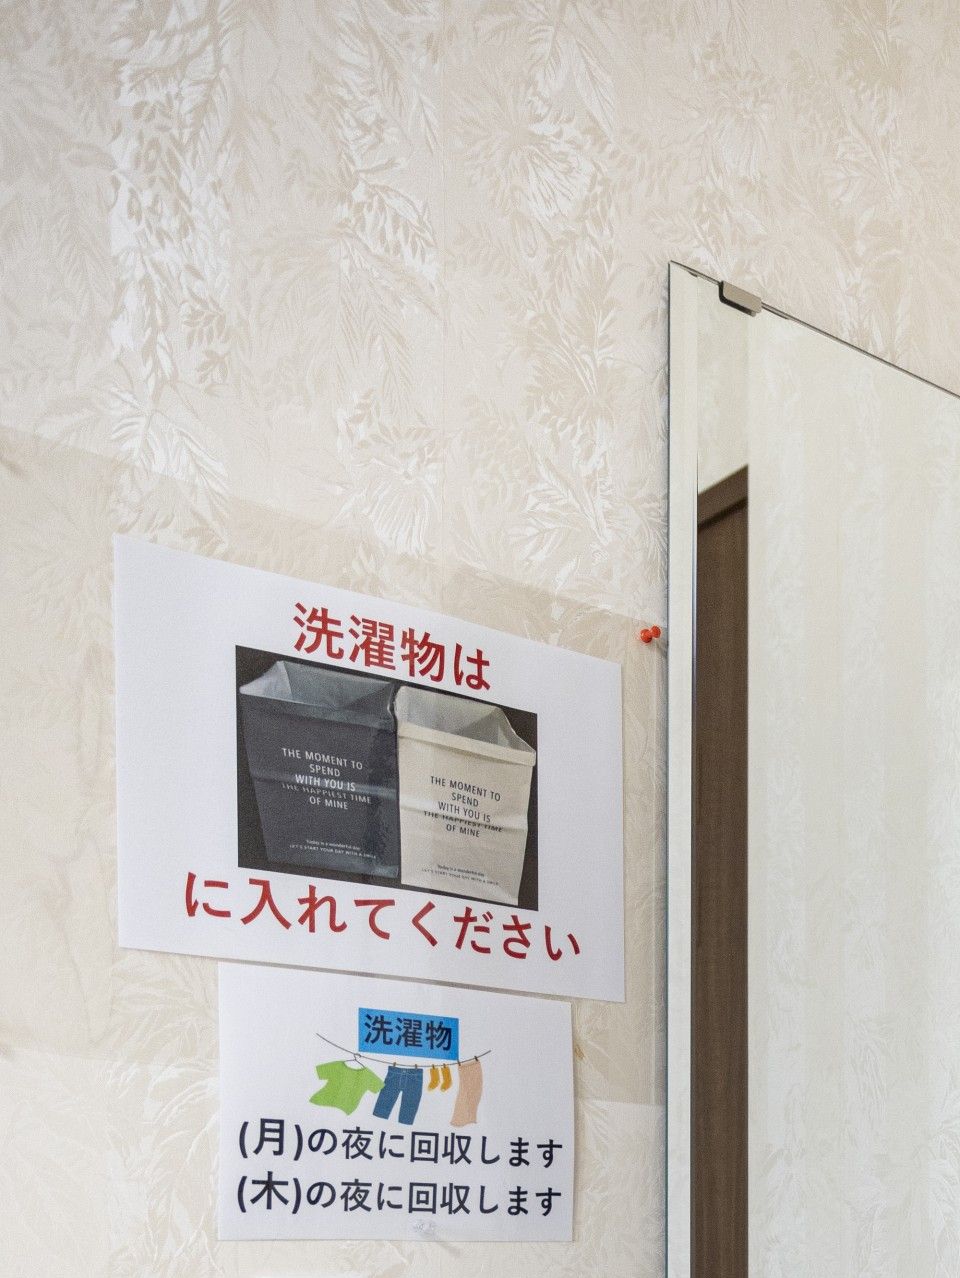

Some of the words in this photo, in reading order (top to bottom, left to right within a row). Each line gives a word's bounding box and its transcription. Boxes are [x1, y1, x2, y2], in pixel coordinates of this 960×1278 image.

[293, 602, 491, 691] 洗濯物は
[282, 748, 301, 759] THE
[305, 751, 347, 767] MOMENT
[352, 761, 363, 770] TO
[309, 764, 341, 777] SPEND
[295, 774, 320, 788] WITH
[324, 779, 343, 790] YOU
[347, 782, 356, 792] IS
[430, 776, 446, 787] THE
[449, 780, 487, 798] MOMENT
[490, 791, 501, 802] TO
[309, 796, 321, 805] OF
[325, 799, 348, 810] MINE
[451, 792, 479, 807] SPEND
[438, 801, 460, 815] WITH
[463, 807, 480, 820] YOU
[483, 814, 491, 823] IS
[446, 824, 456, 832] OF
[460, 827, 480, 838] MINE
[185, 871, 580, 962] に入れてください
[364, 1013, 452, 1052] 洗濯物
[239, 1118, 563, 1169] (月)の夜に回収します
[237, 1171, 562, 1217] (木)の夜に回収します
